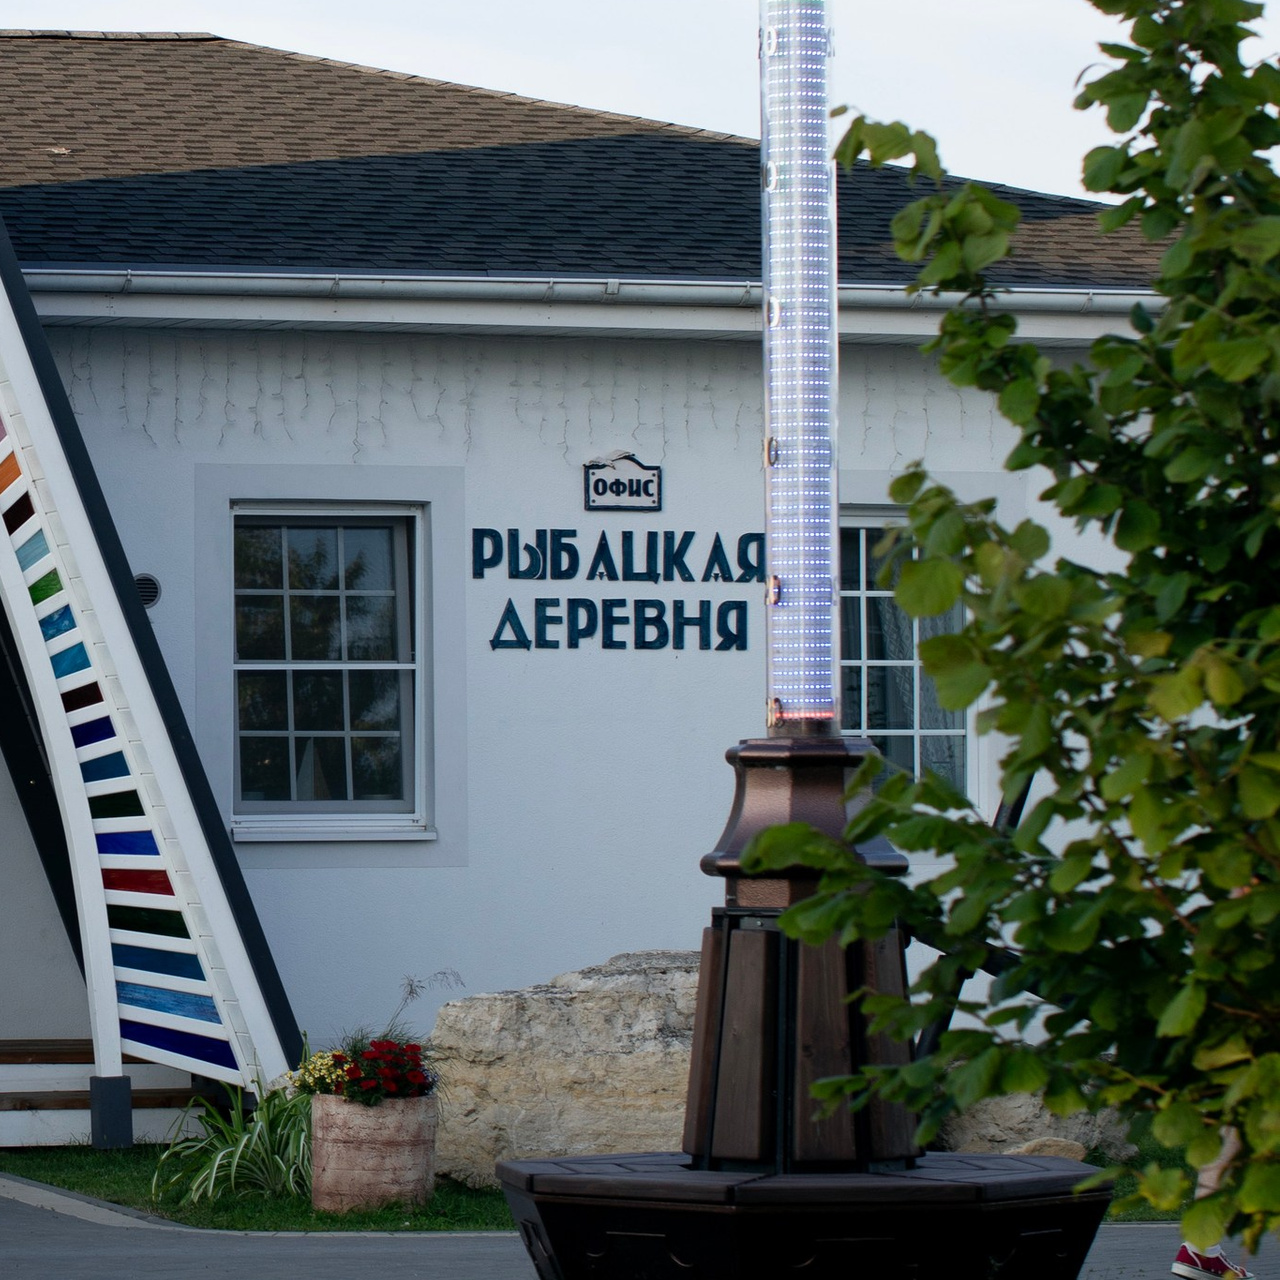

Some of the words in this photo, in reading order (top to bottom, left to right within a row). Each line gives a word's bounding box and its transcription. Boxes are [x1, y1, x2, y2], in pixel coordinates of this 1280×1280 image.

[593, 478, 654, 498] ОФИС
[471, 527, 766, 584] РЫБАЦКАЯ
[488, 597, 748, 651] ДЕРЕВНЯ
